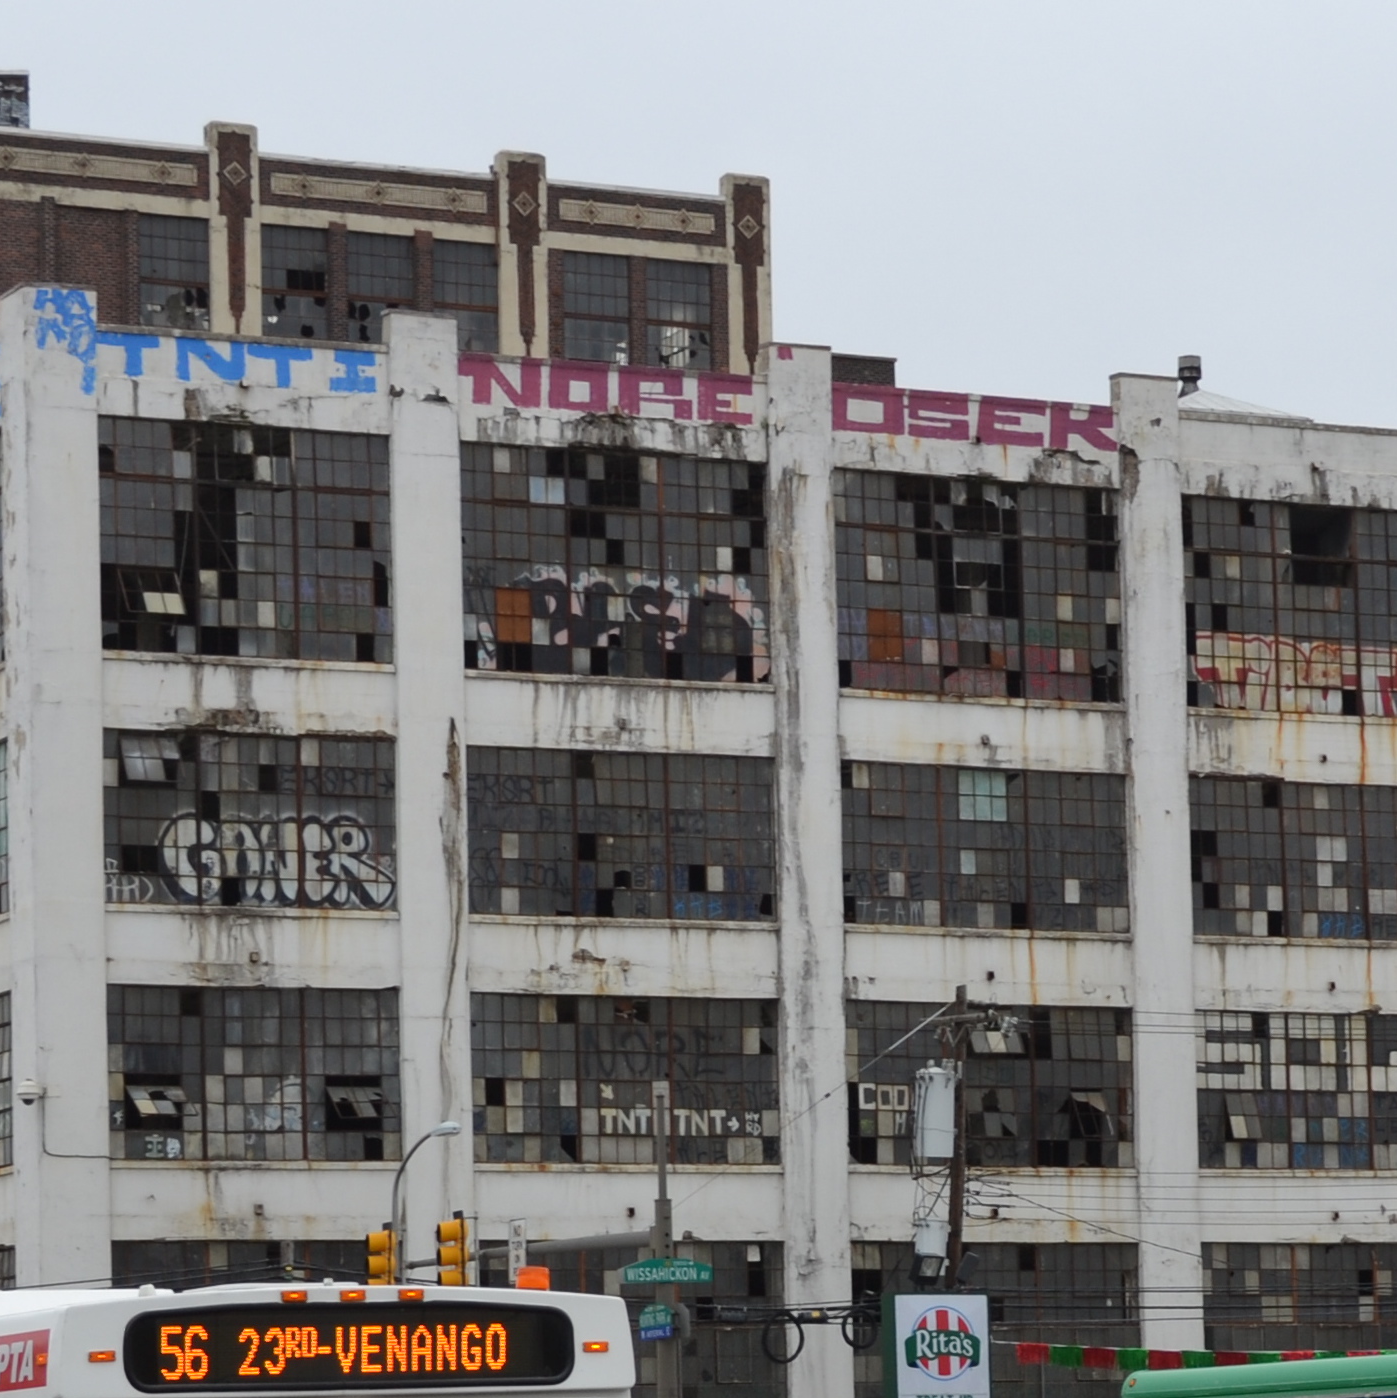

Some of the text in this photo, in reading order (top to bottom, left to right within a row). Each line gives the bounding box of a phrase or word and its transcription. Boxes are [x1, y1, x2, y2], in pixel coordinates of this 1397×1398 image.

[600, 1108, 726, 1136] TNT TNT
[626, 1267, 697, 1281] WISSAHICKON
[160, 1326, 208, 1380] 56
[916, 1329, 974, 1358] Rita's
